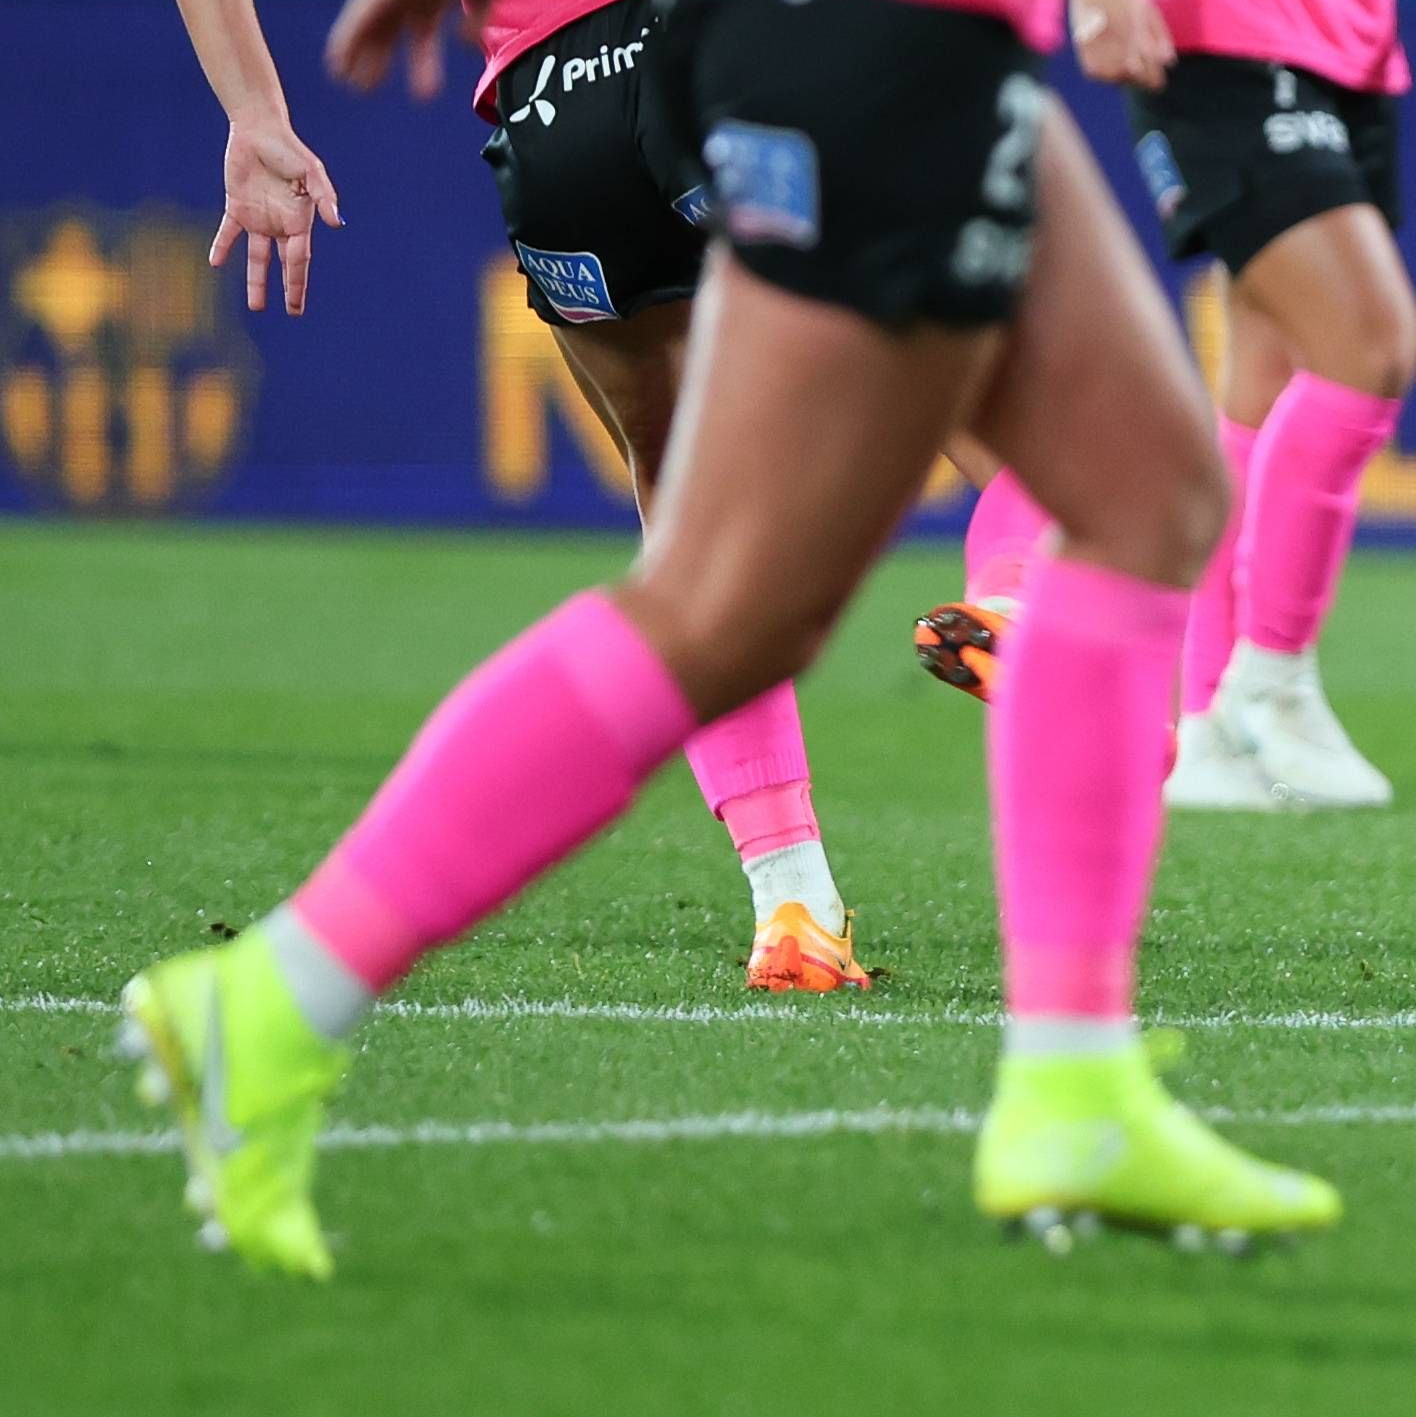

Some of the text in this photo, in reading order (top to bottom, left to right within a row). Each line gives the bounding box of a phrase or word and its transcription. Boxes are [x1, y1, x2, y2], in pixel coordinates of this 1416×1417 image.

[562, 27, 650, 92] Prim
[526, 252, 597, 283] AQUA
[538, 274, 601, 306] DEUS
